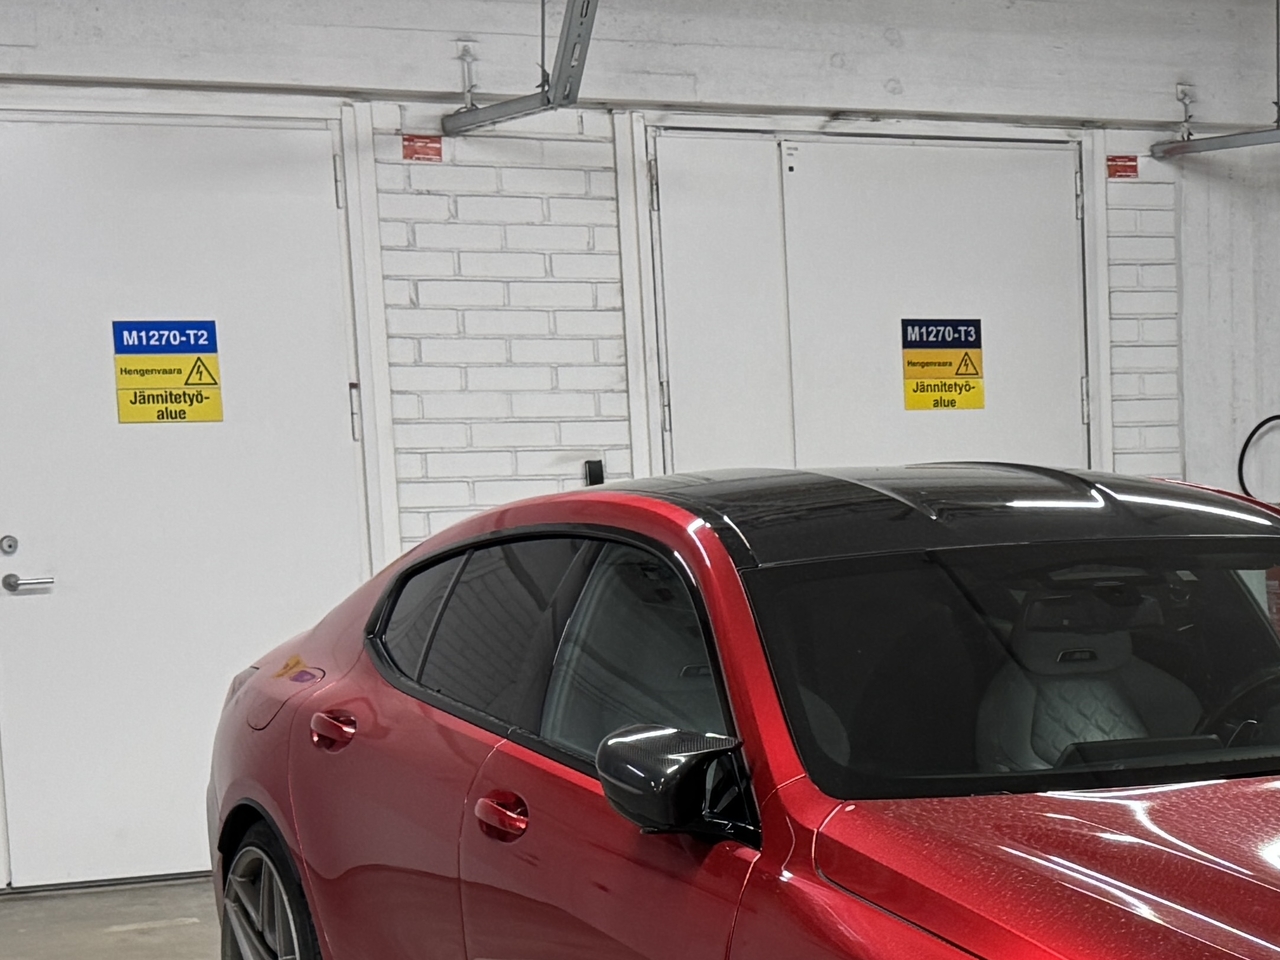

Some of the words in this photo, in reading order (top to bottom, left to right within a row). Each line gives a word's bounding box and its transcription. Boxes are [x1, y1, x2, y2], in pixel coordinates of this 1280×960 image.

[123, 330, 209, 346] M1270-T2
[907, 326, 976, 341] M1270-T3
[120, 367, 182, 377] Hengenvaara
[129, 390, 210, 407] Jännitetyö-
[932, 396, 957, 408] alue
[156, 407, 187, 420] alue
